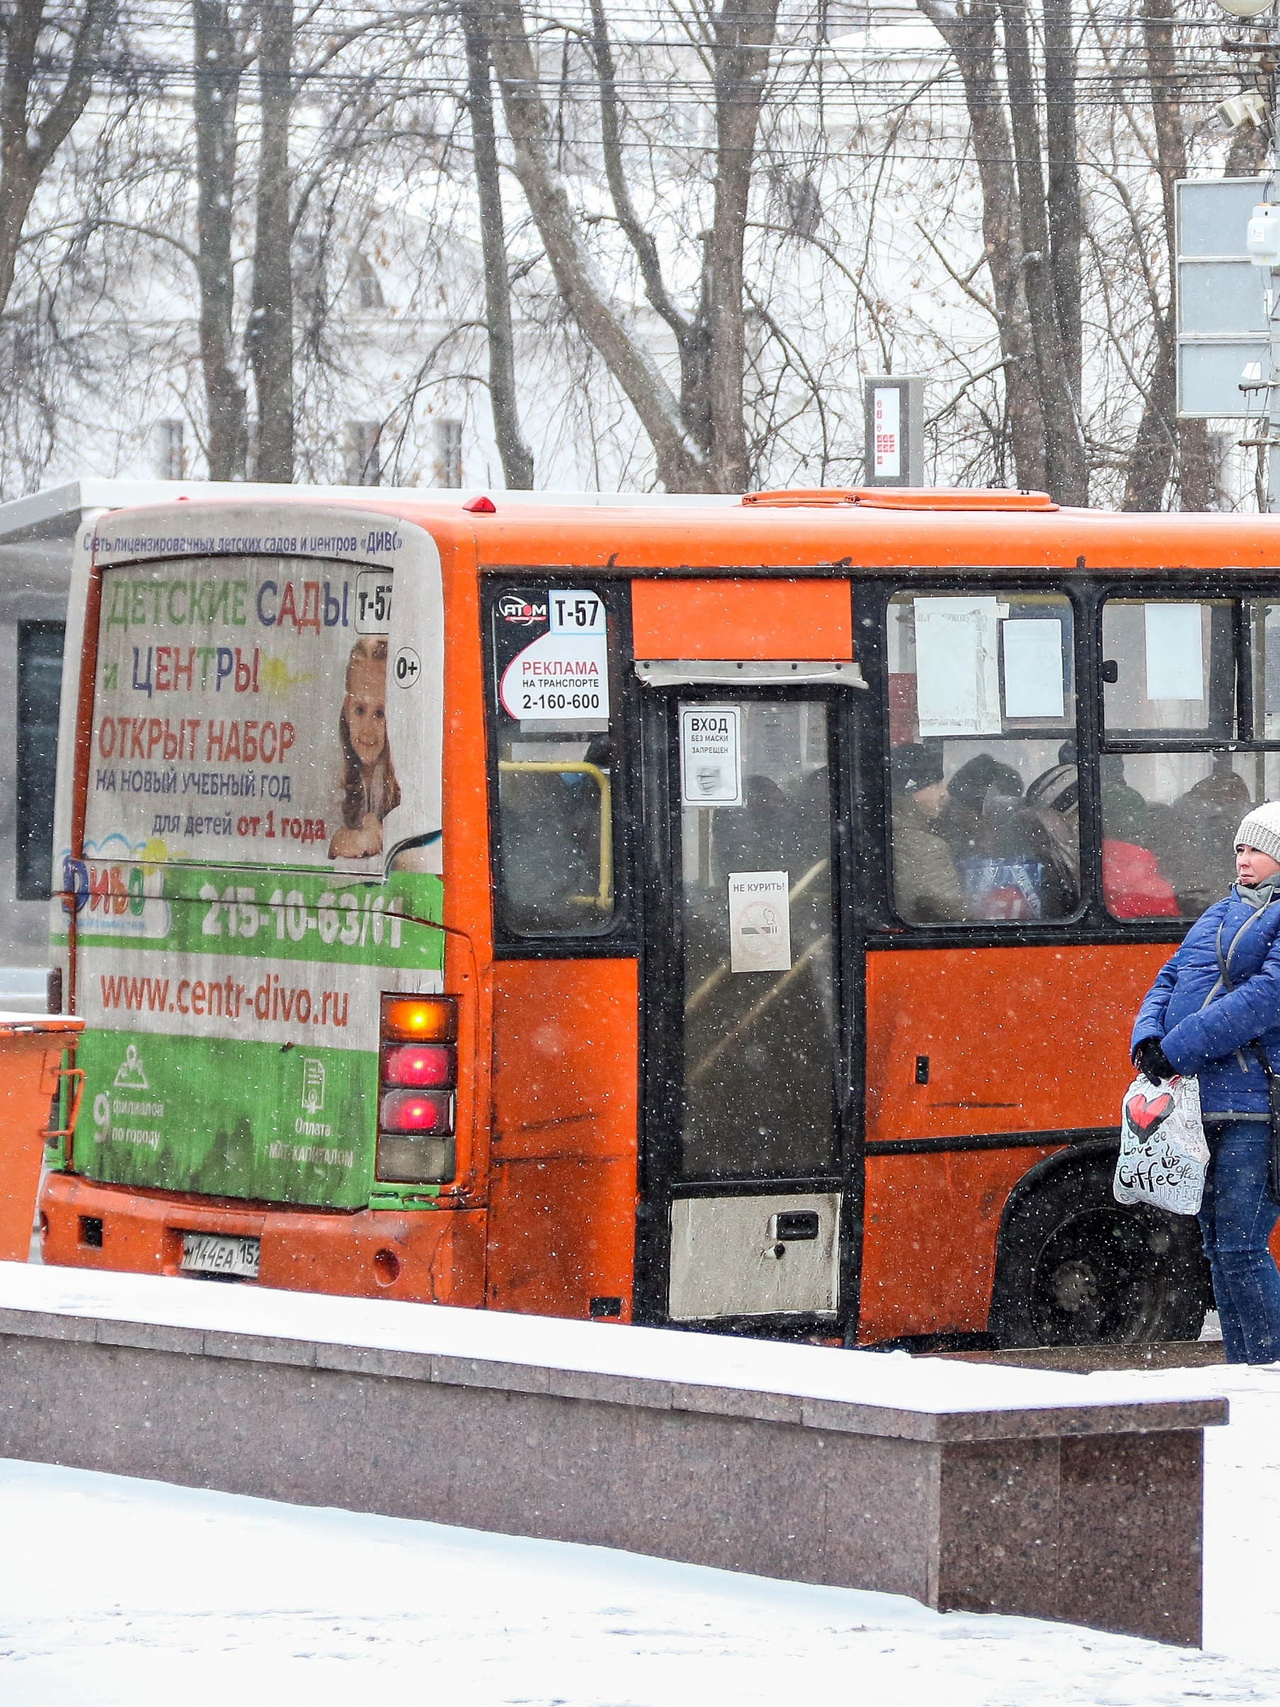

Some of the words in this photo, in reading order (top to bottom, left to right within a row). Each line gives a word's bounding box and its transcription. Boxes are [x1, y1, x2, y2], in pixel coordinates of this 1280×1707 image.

[264, 536, 297, 552] садов
[300, 536, 308, 551] и
[310, 536, 357, 556] центров
[107, 580, 247, 632] ДЕТСКИЕ
[256, 580, 348, 635] САДЫ
[103, 662, 118, 691] и
[133, 646, 260, 698] ЦЕНТРЫ
[396, 659, 418, 681] 0+
[522, 661, 599, 675] РЕКЛАМА
[522, 679, 536, 688] НА
[539, 679, 600, 688] ТРАНСПОРТЕ
[522, 693, 600, 709] 2-160-600
[691, 718, 728, 734] ВХОД
[100, 716, 201, 761] ОТКРЫТ
[206, 720, 295, 764] НАБОР
[691, 734, 704, 743] БЕЗ
[705, 734, 729, 743] МАСКИ
[691, 746, 729, 756] ЗАПРЕЩЕН
[96, 769, 117, 791] НА
[120, 767, 177, 794] НОВЫЙ
[182, 769, 255, 798] УЧЕБНЫЙ
[260, 774, 291, 802] ГОД
[152, 814, 179, 836] для
[183, 811, 232, 839] детей
[237, 815, 260, 837] от
[265, 810, 276, 838] 1
[281, 816, 326, 840] года
[733, 883, 746, 893] НЕ
[747, 882, 785, 893] КУРИТЬ!
[101, 972, 349, 1028] www.centr-divo.ru
[295, 1117, 331, 1137] Оплата
[1123, 1142, 1158, 1157] Love
[1119, 1160, 1184, 1193] Coffee
